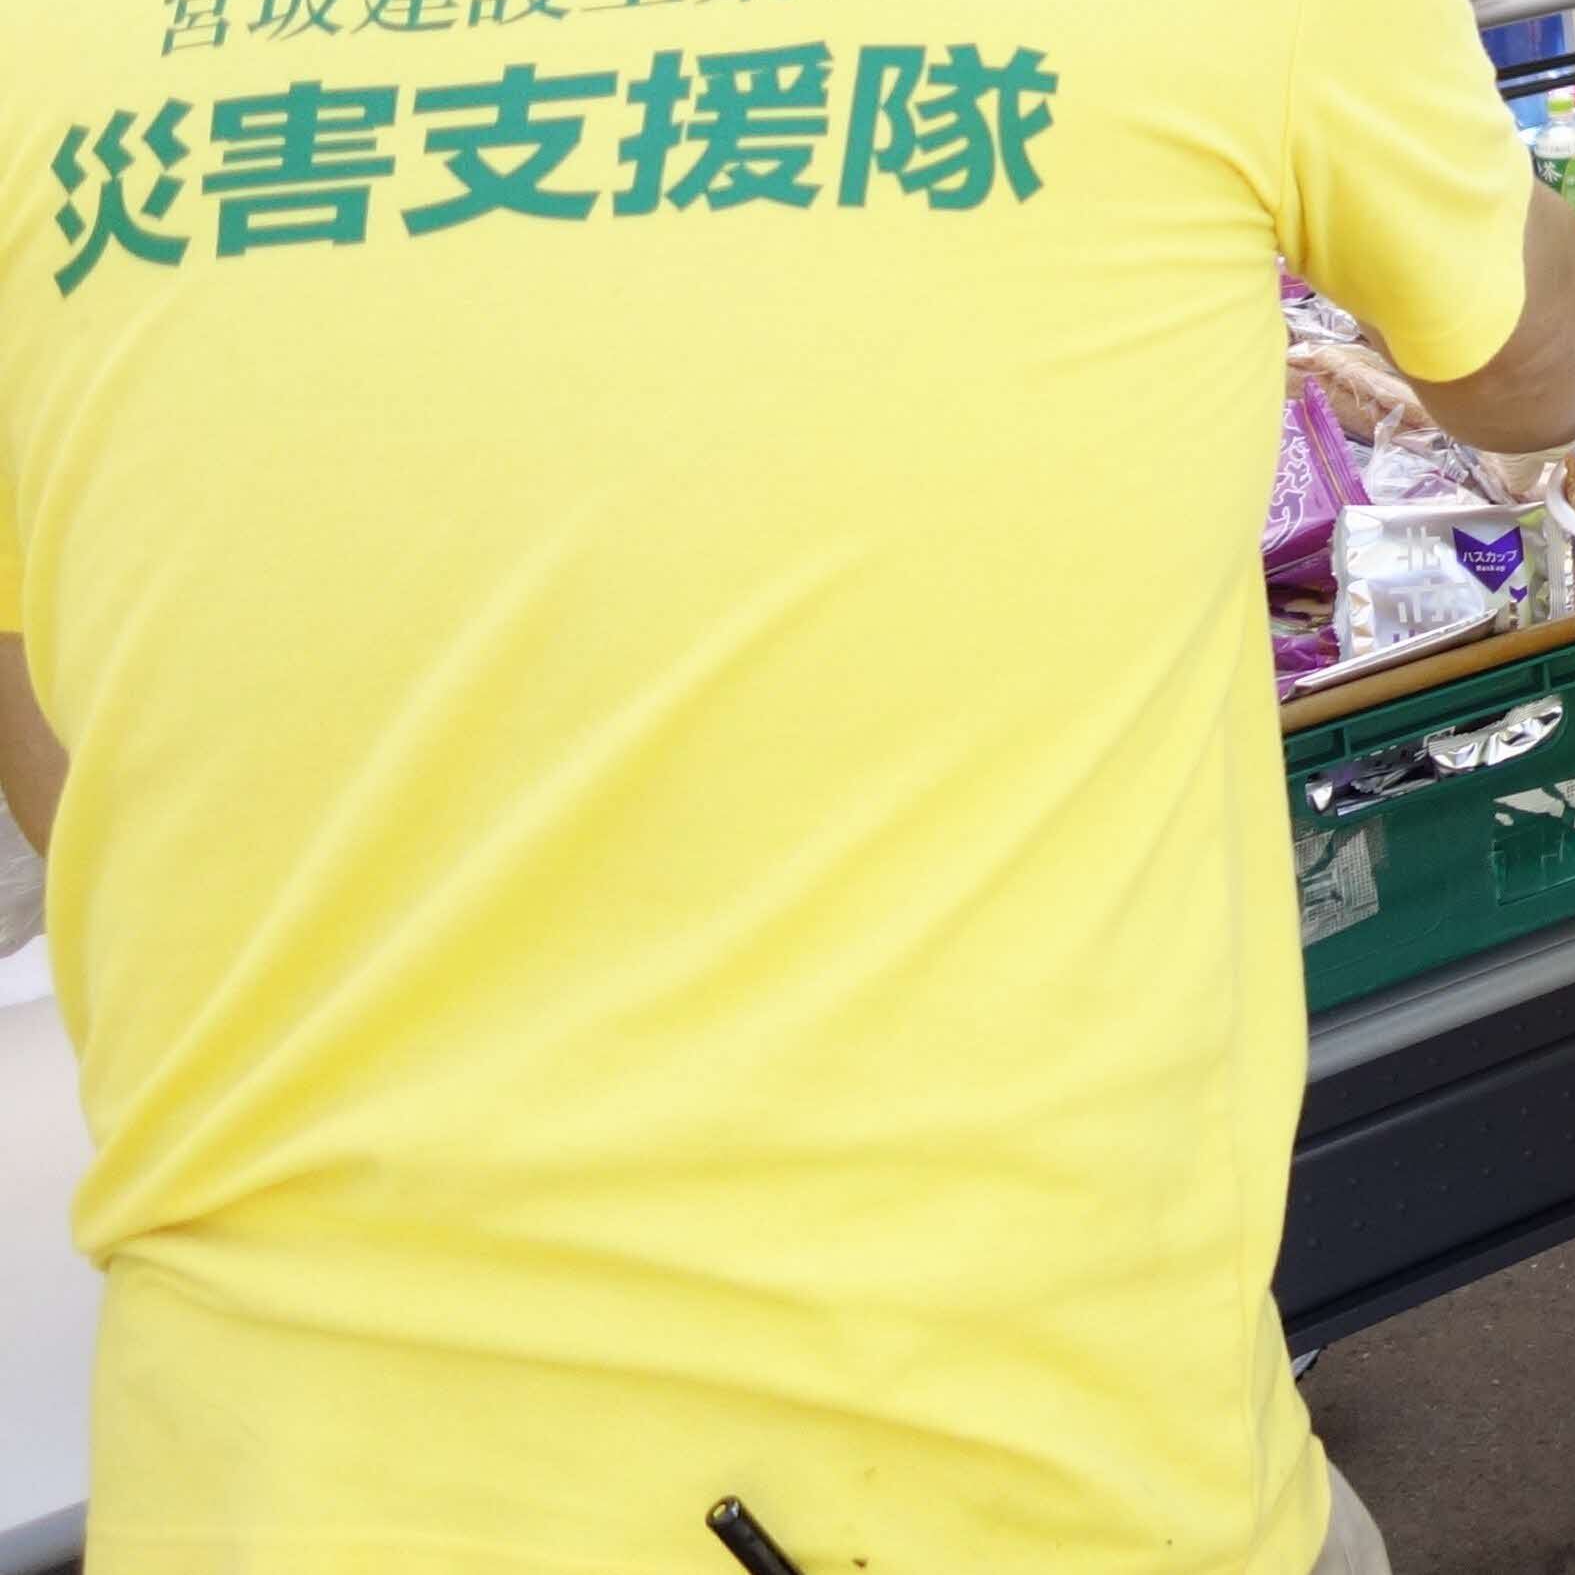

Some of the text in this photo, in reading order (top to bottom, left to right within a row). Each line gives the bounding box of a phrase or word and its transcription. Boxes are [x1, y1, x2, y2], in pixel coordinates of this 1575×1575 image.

[48, 41, 1059, 299] 災害支援隊
[1463, 549, 1519, 564] ハスカップ
